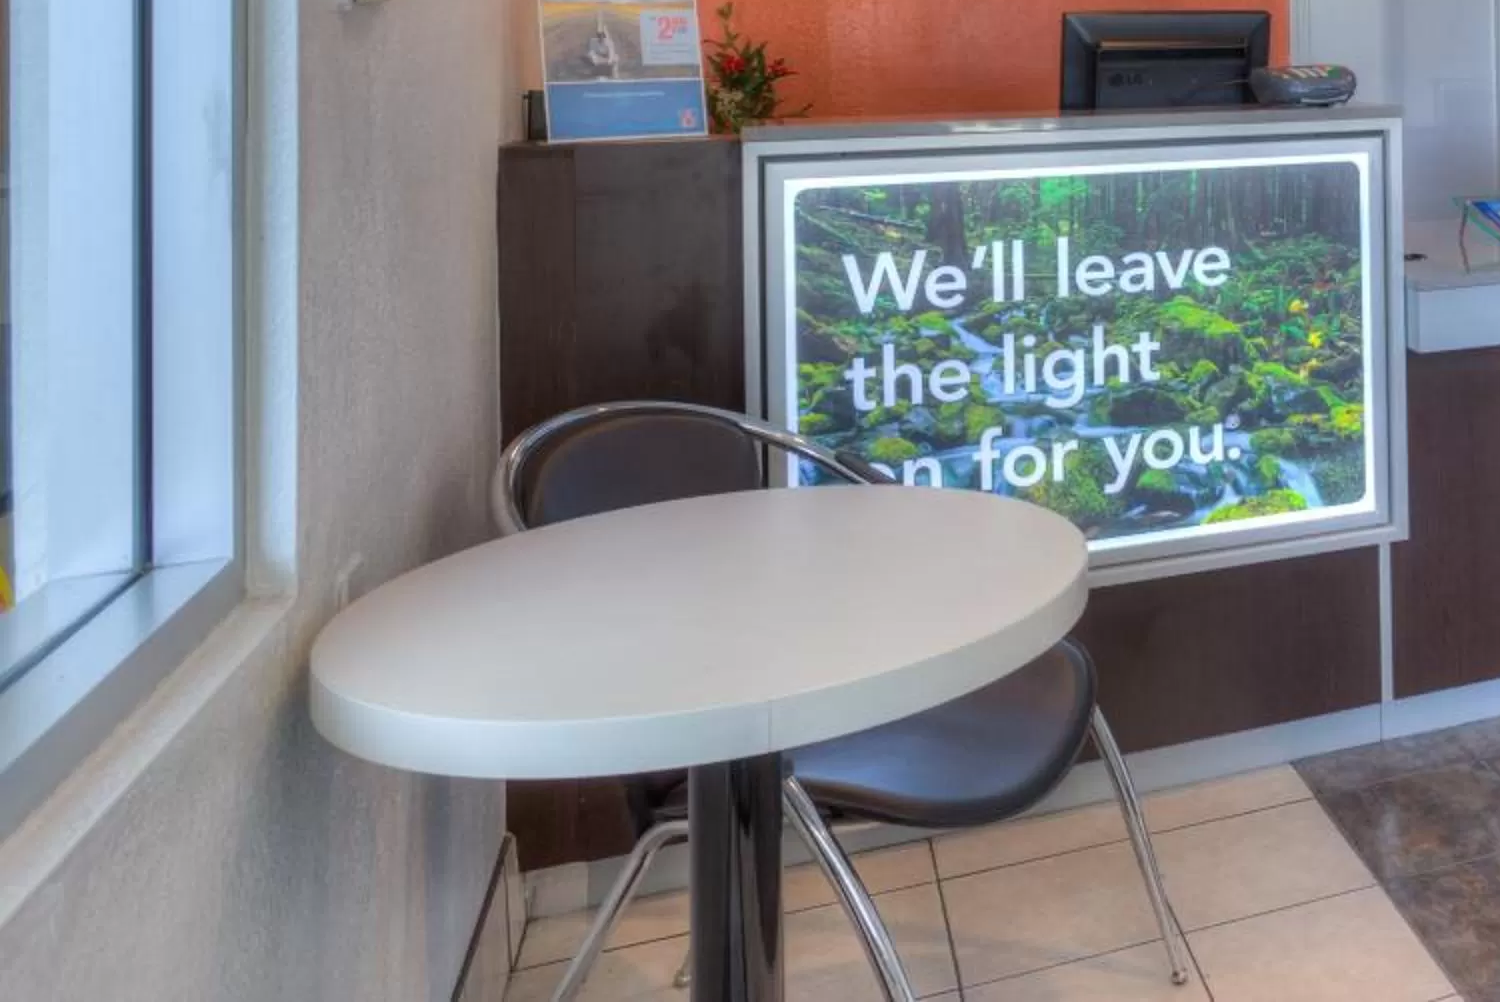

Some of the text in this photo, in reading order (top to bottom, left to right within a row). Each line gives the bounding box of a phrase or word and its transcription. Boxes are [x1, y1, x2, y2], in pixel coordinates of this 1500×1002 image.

[843, 236, 1231, 315] We'll leave
[845, 325, 1162, 413] the light
[868, 422, 1241, 494] n for you.
